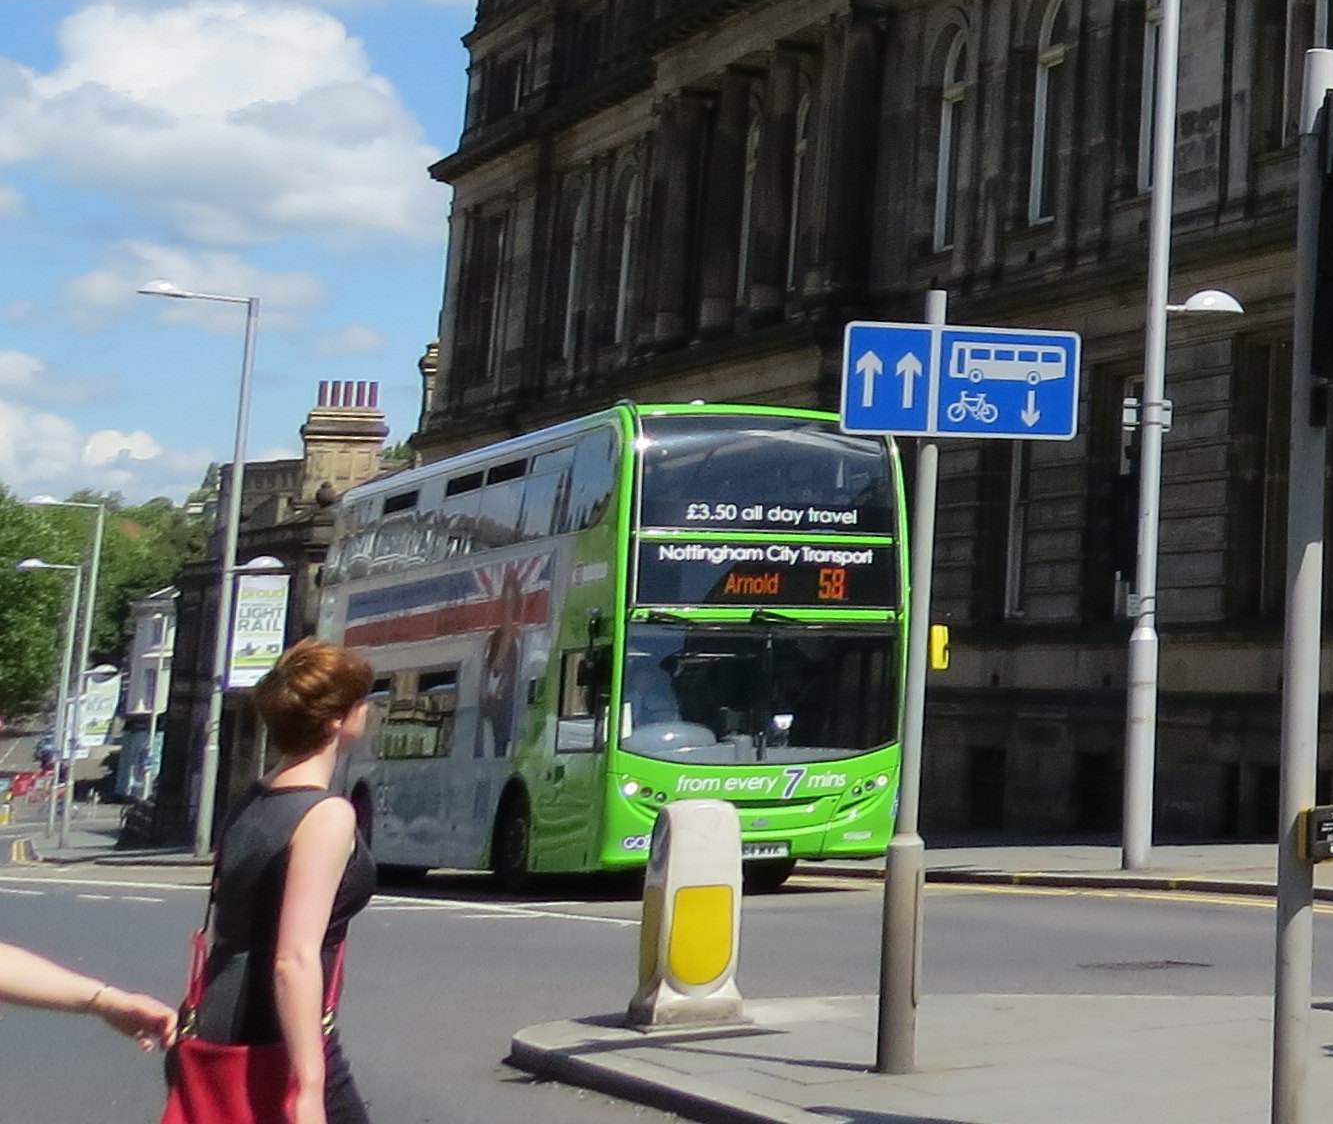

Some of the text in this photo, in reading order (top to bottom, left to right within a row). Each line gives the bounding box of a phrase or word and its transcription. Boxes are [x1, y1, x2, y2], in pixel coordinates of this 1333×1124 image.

[685, 503, 858, 525] £3.50 all day travel
[658, 544, 873, 567] Nottingham City Transport
[724, 568, 846, 600] Arnold 58
[239, 607, 284, 619] LIGHT
[237, 619, 283, 632] RAIL
[675, 766, 847, 800] from every 7 mins
